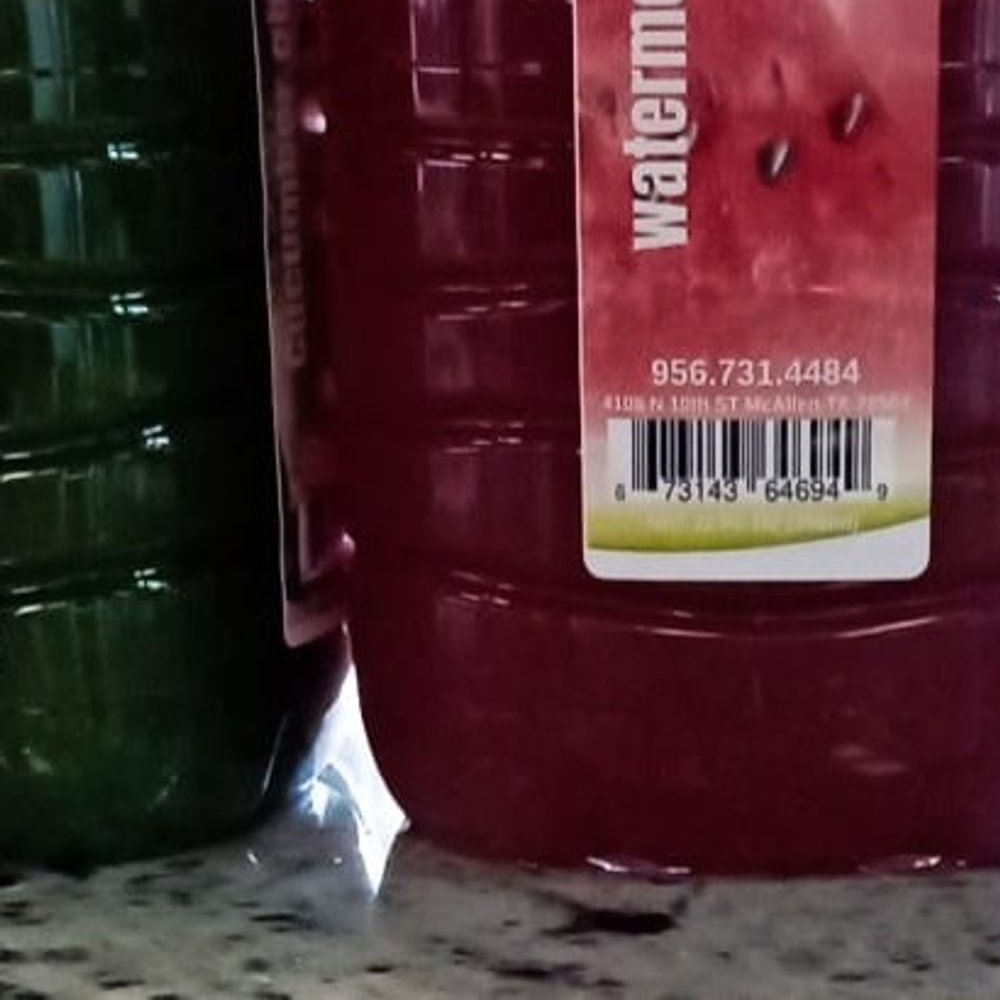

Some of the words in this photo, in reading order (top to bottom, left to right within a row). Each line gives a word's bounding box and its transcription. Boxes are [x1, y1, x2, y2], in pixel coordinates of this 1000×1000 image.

[652, 357, 861, 388] 956.731.4484
[663, 480, 739, 502] 73143
[764, 480, 839, 502] 64694
